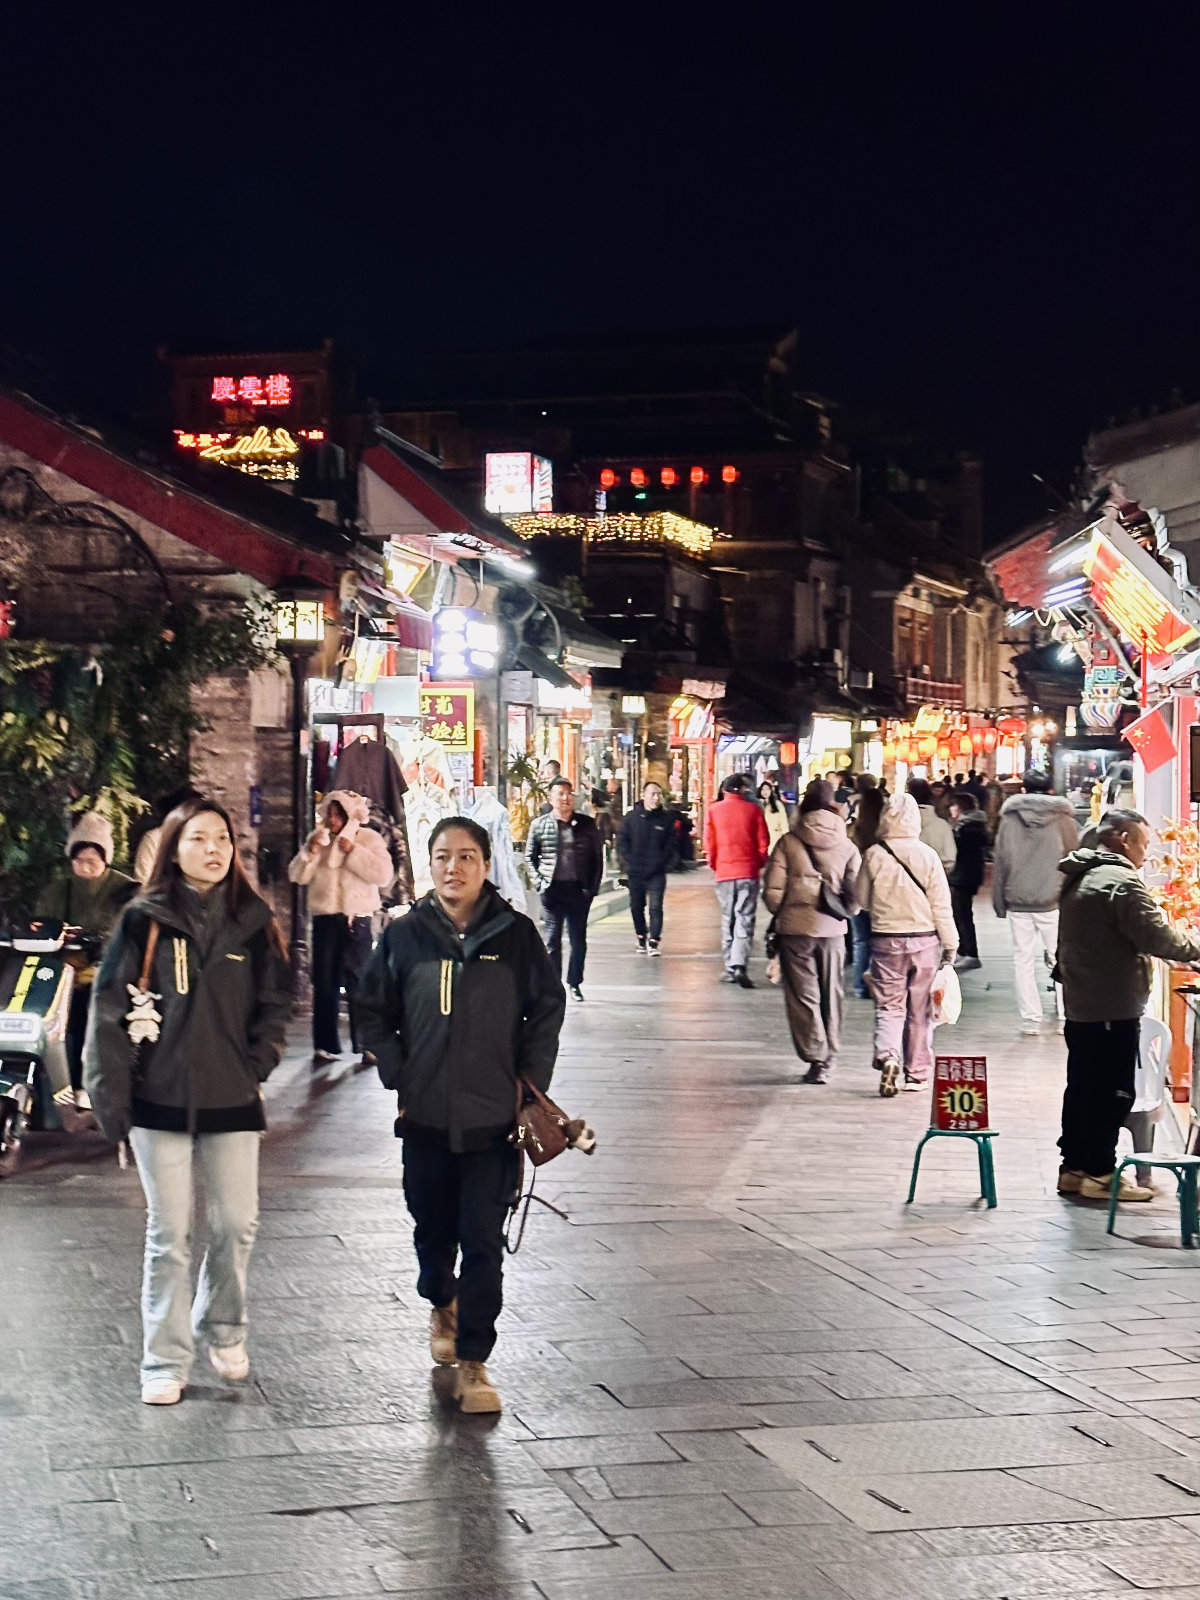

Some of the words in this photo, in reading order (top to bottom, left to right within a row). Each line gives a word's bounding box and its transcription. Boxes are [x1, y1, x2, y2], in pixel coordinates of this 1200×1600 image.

[211, 374, 291, 401] 慶雲樓
[425, 721, 466, 740] 验店
